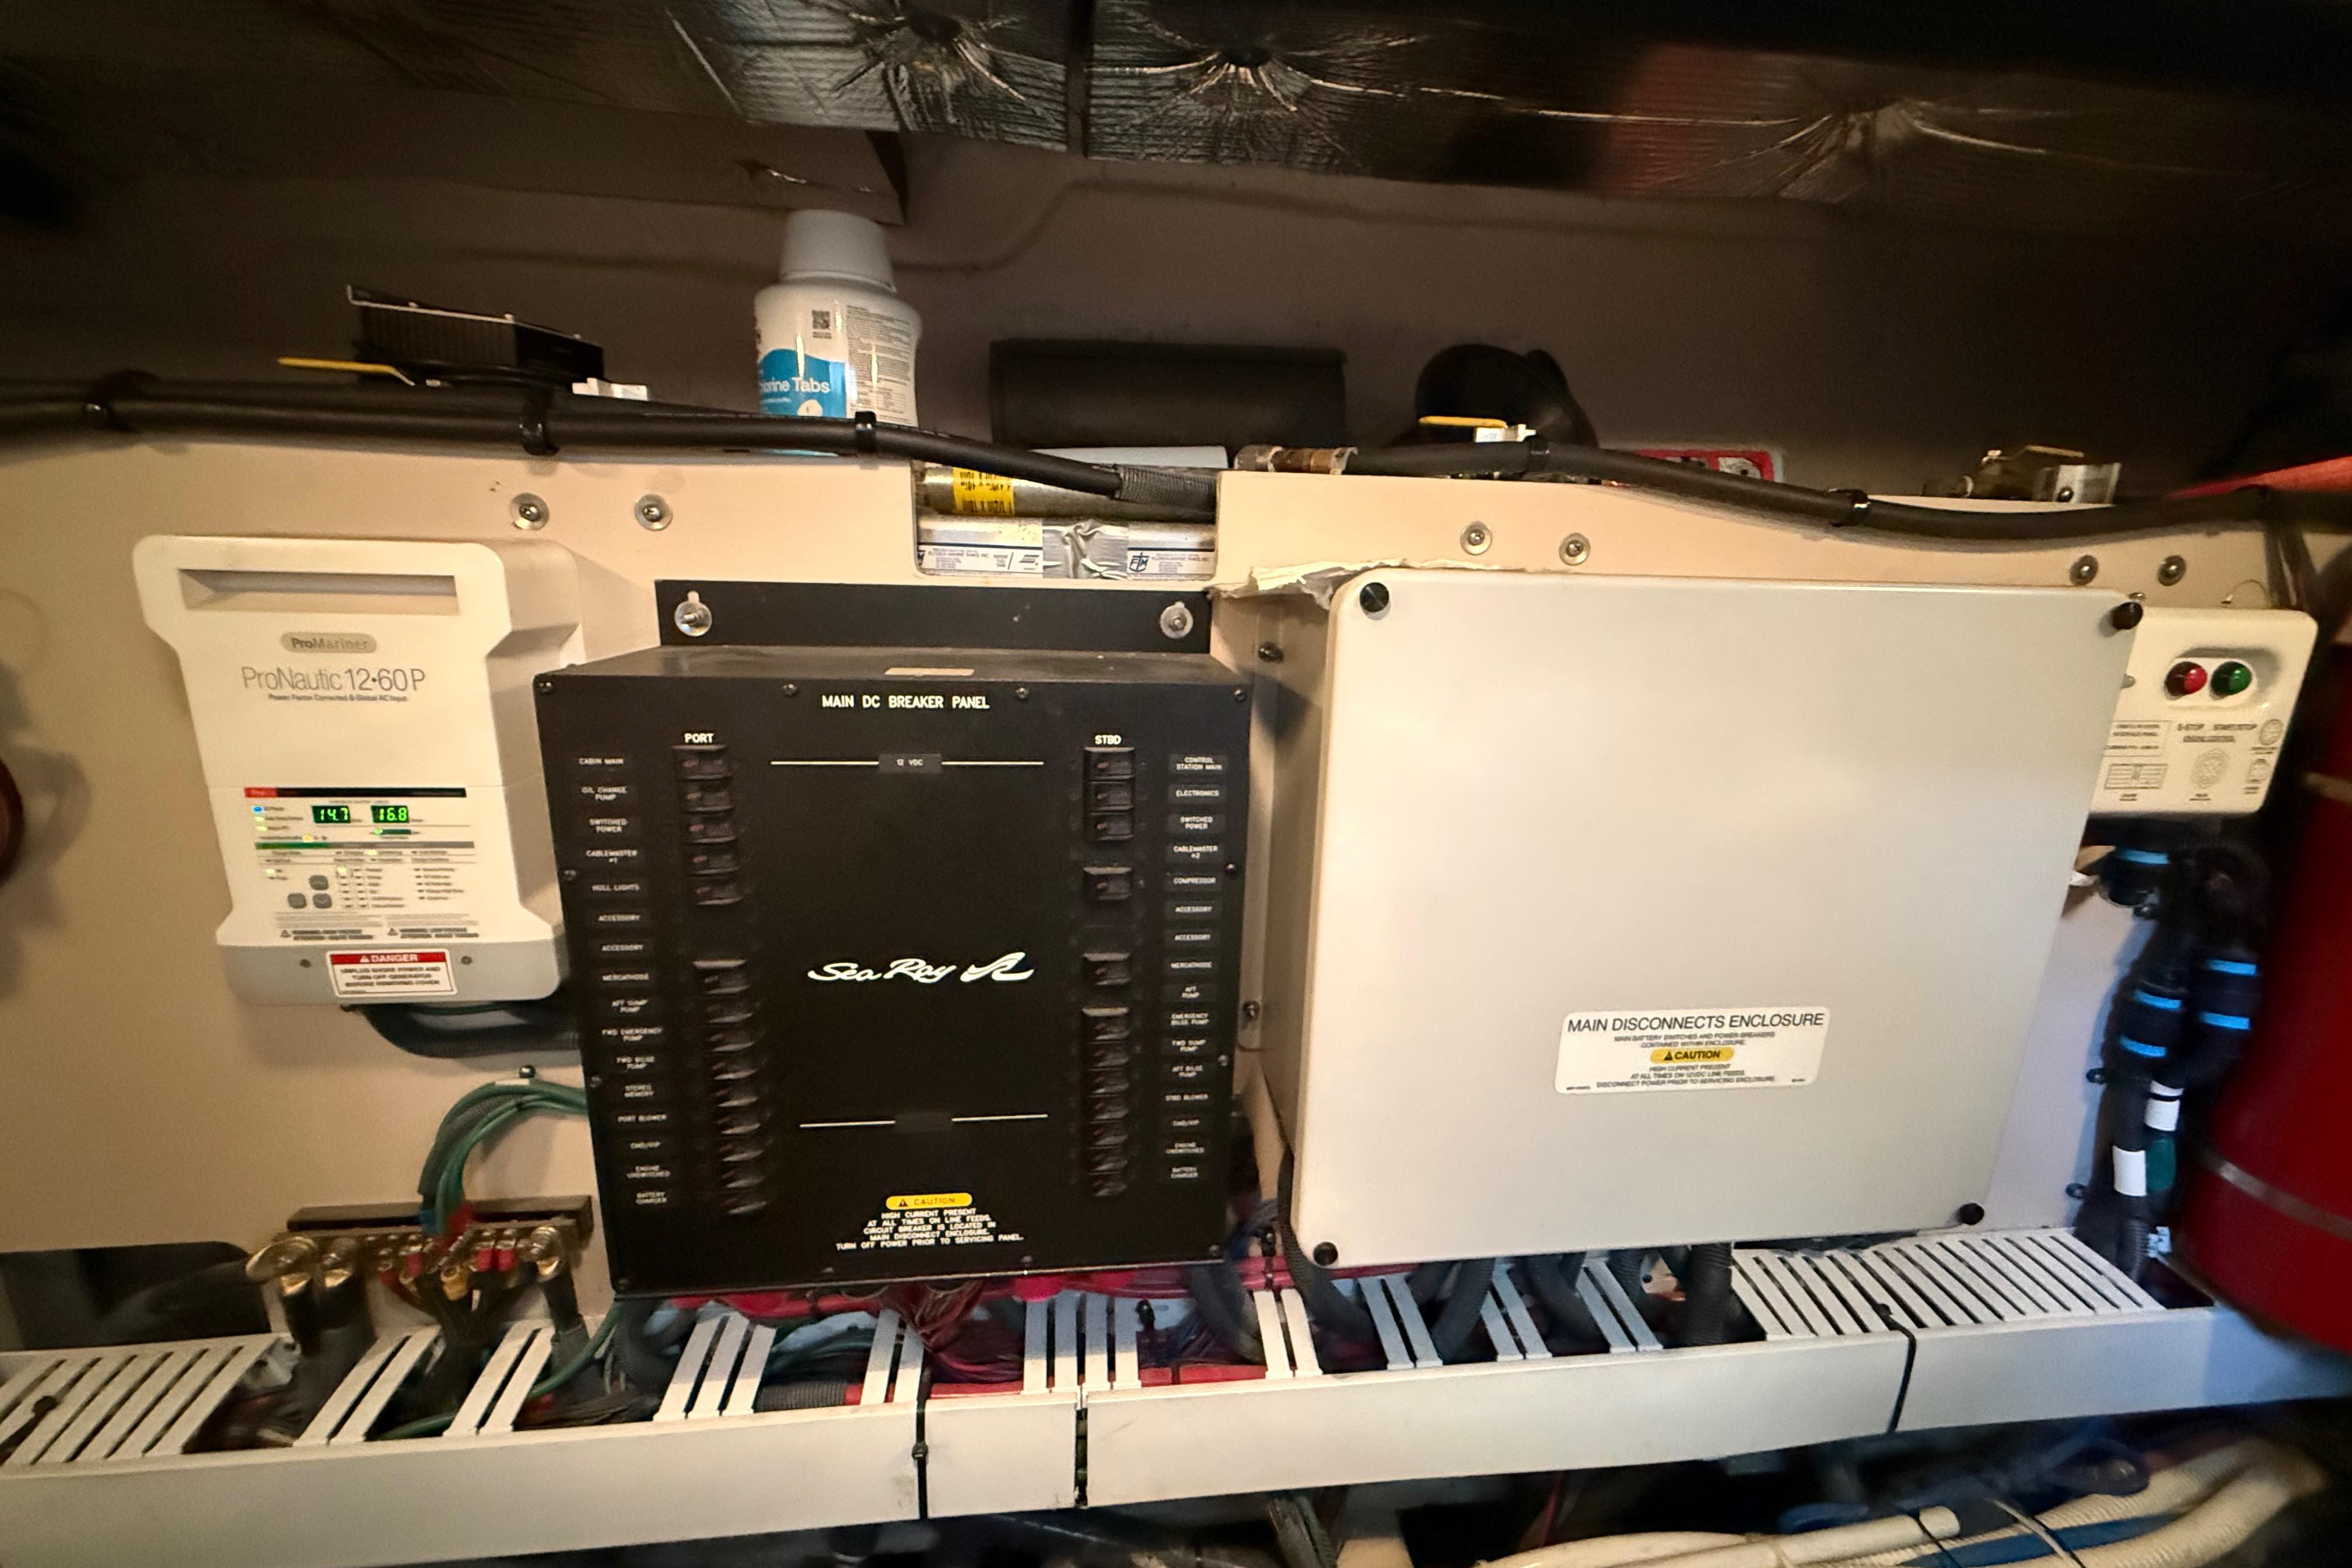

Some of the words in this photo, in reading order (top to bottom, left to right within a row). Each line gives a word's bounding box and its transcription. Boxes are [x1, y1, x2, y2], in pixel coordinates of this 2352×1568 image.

[792, 377, 831, 394] Tabs
[292, 638, 368, 649] ProMariner
[242, 667, 342, 691] ProNautic
[822, 695, 854, 708] MAIN
[862, 695, 880, 708] DC
[888, 695, 944, 709] BREAKER
[952, 696, 990, 709] PANEL
[684, 733, 714, 744] PORT
[1094, 734, 1122, 745] STBD
[597, 786, 628, 794] CHANGE
[614, 883, 640, 891] LIGHTS
[371, 954, 418, 963] DANGER
[807, 962, 883, 981] Sea
[883, 957, 957, 984] Ray
[1567, 1018, 1608, 1032] MAIN
[1611, 1015, 1726, 1031] DISCONNECTS
[1728, 1013, 1825, 1028] ENCLOSURE
[1675, 1050, 1721, 1060] CAUTION
[914, 1197, 956, 1206] CAUTION
[881, 1212, 901, 1220] HIGH
[905, 1210, 939, 1219] CURRENT
[943, 1208, 977, 1216] PRESENT
[944, 1216, 961, 1224] LINE
[863, 1226, 894, 1235] CIRCUIT
[898, 1224, 932, 1233] BREAKER
[950, 1222, 983, 1230] LOCATED
[894, 1230, 941, 1240] DISCONNECT
[835, 1242, 857, 1251] TURN
[860, 1241, 876, 1249] OFF
[880, 1240, 908, 1248] POWER
[912, 1238, 935, 1247] PRIOR
[954, 1234, 995, 1244] SERVICING
